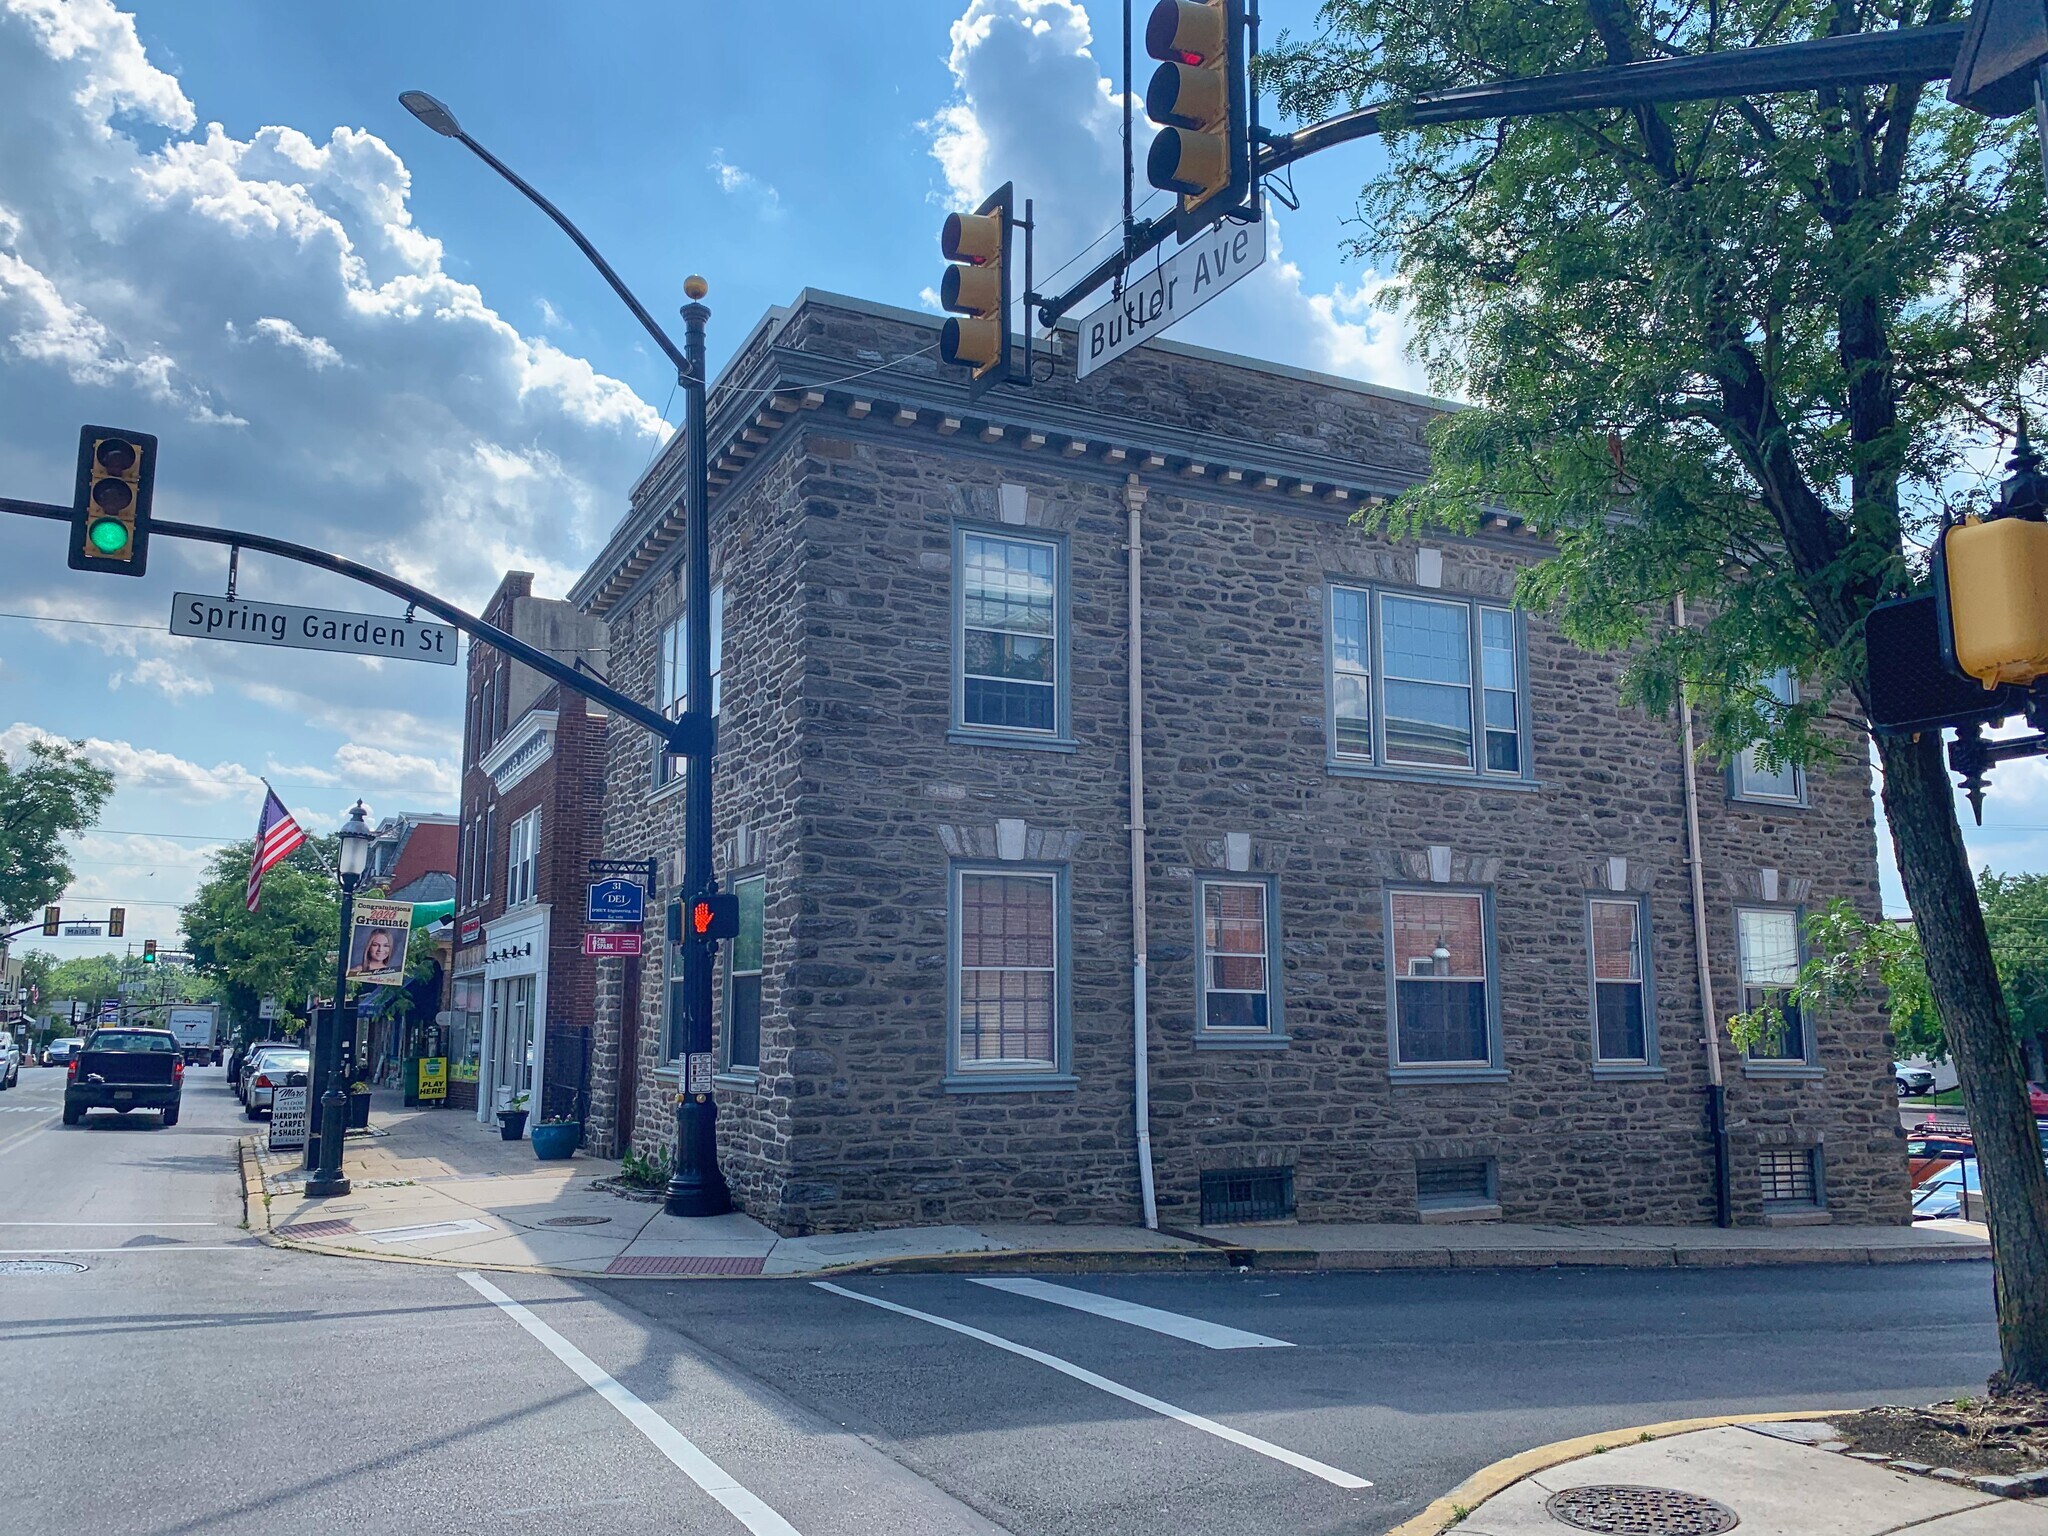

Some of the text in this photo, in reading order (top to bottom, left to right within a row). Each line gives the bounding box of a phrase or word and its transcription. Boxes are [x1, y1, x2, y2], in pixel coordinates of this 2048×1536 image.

[1091, 229, 1249, 359] Butler Ave
[188, 602, 444, 652] Spring Garden St
[612, 882, 621, 890] 31
[608, 895, 625, 903] DEI
[357, 902, 411, 912] Congratulations
[369, 910, 397, 919] 2020
[356, 916, 409, 928] Graduate
[278, 1088, 305, 1098] Maro
[274, 1112, 306, 1120] HARDWO
[278, 1128, 305, 1137] SHADES
